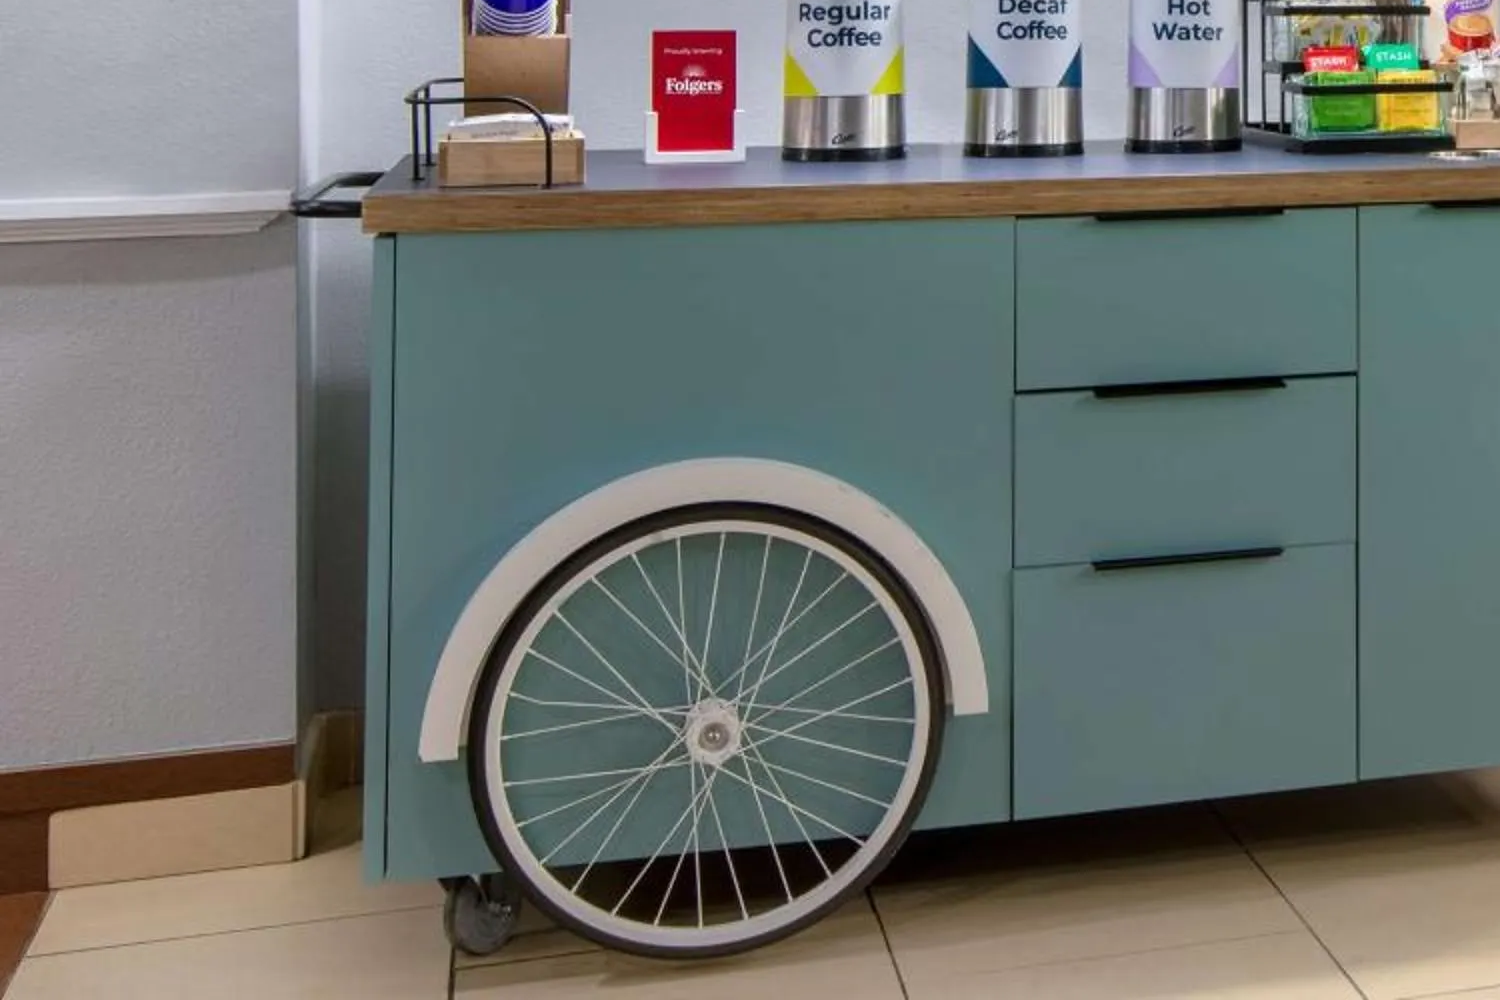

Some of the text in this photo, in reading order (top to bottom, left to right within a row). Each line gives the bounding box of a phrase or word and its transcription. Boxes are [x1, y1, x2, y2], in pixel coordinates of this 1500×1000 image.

[799, 0, 890, 25] Regular
[807, 26, 882, 48] Coffee
[996, 20, 1068, 41] Coffee
[1152, 22, 1223, 41] Water
[1375, 51, 1412, 62] STASH
[665, 77, 723, 96] Folgers
